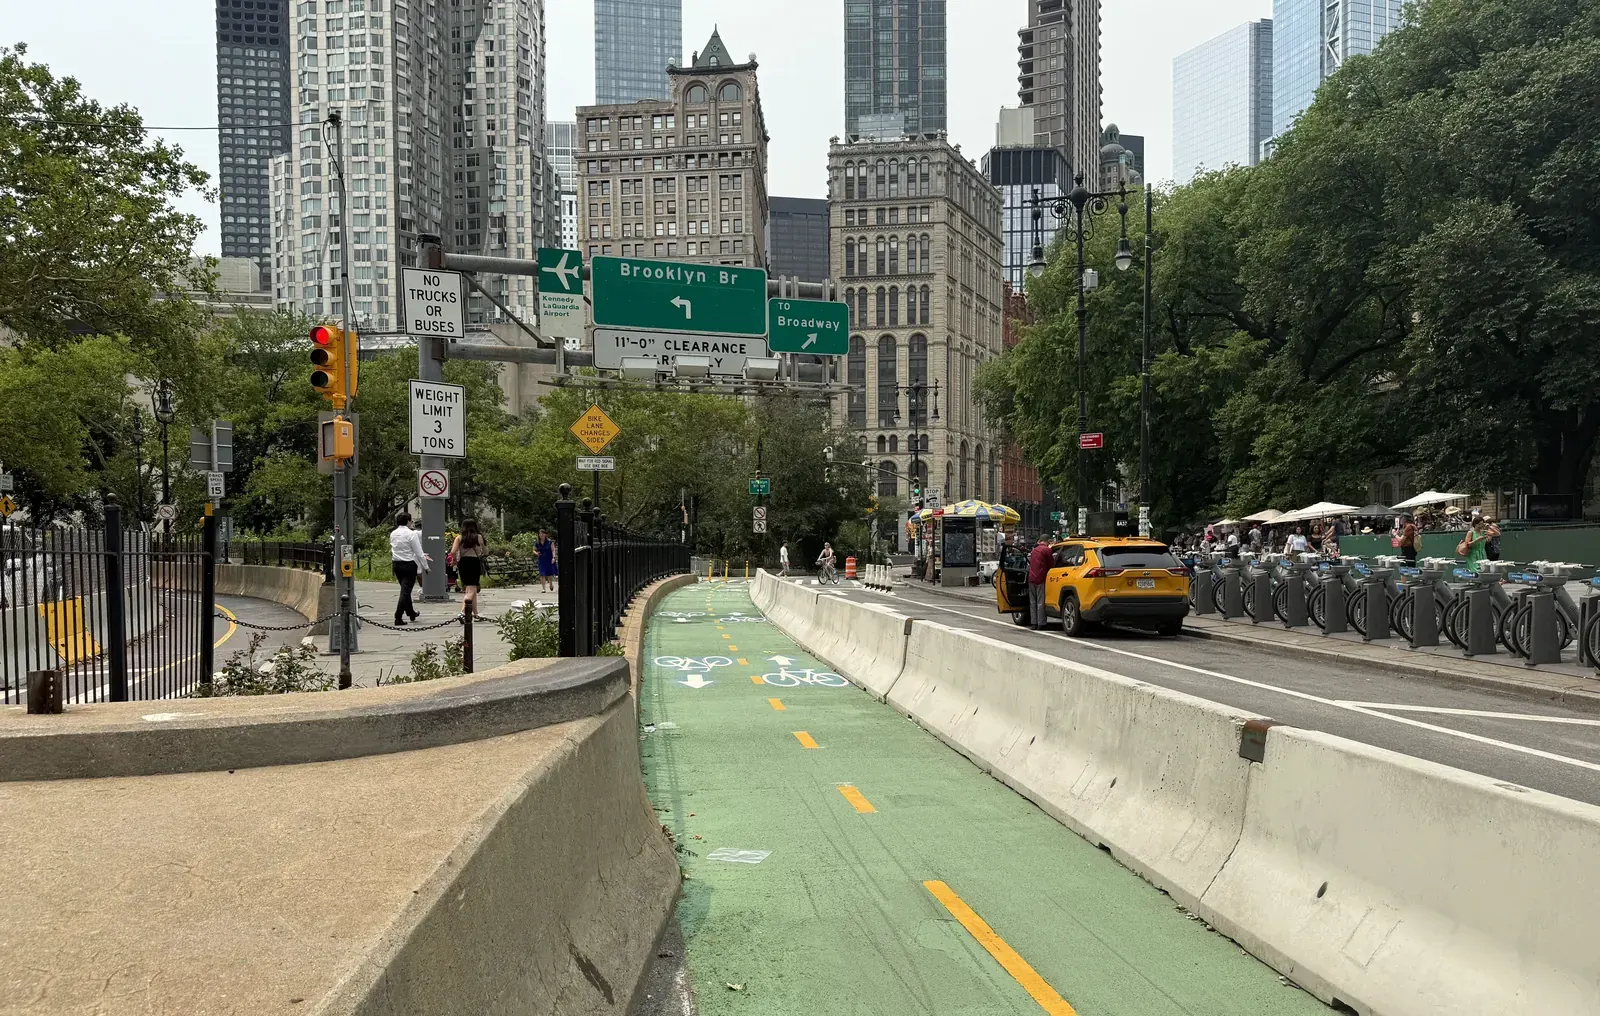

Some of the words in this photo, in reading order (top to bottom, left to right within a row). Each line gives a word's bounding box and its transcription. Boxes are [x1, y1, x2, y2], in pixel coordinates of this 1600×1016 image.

[424, 275, 440, 286] NO
[620, 263, 706, 284] Brooklyn
[720, 271, 738, 285] Br
[409, 288, 456, 303] TRUCKS
[543, 296, 574, 304] Kennedy
[426, 305, 442, 317] OR
[778, 302, 790, 310] TO
[415, 320, 454, 333] BUSES
[778, 316, 840, 331] Broadway
[664, 340, 746, 354] CLEARANCE
[415, 388, 459, 403] WEIGHT
[422, 404, 453, 417] LIMIT
[434, 420, 442, 433] 3
[423, 436, 454, 449] TONS
